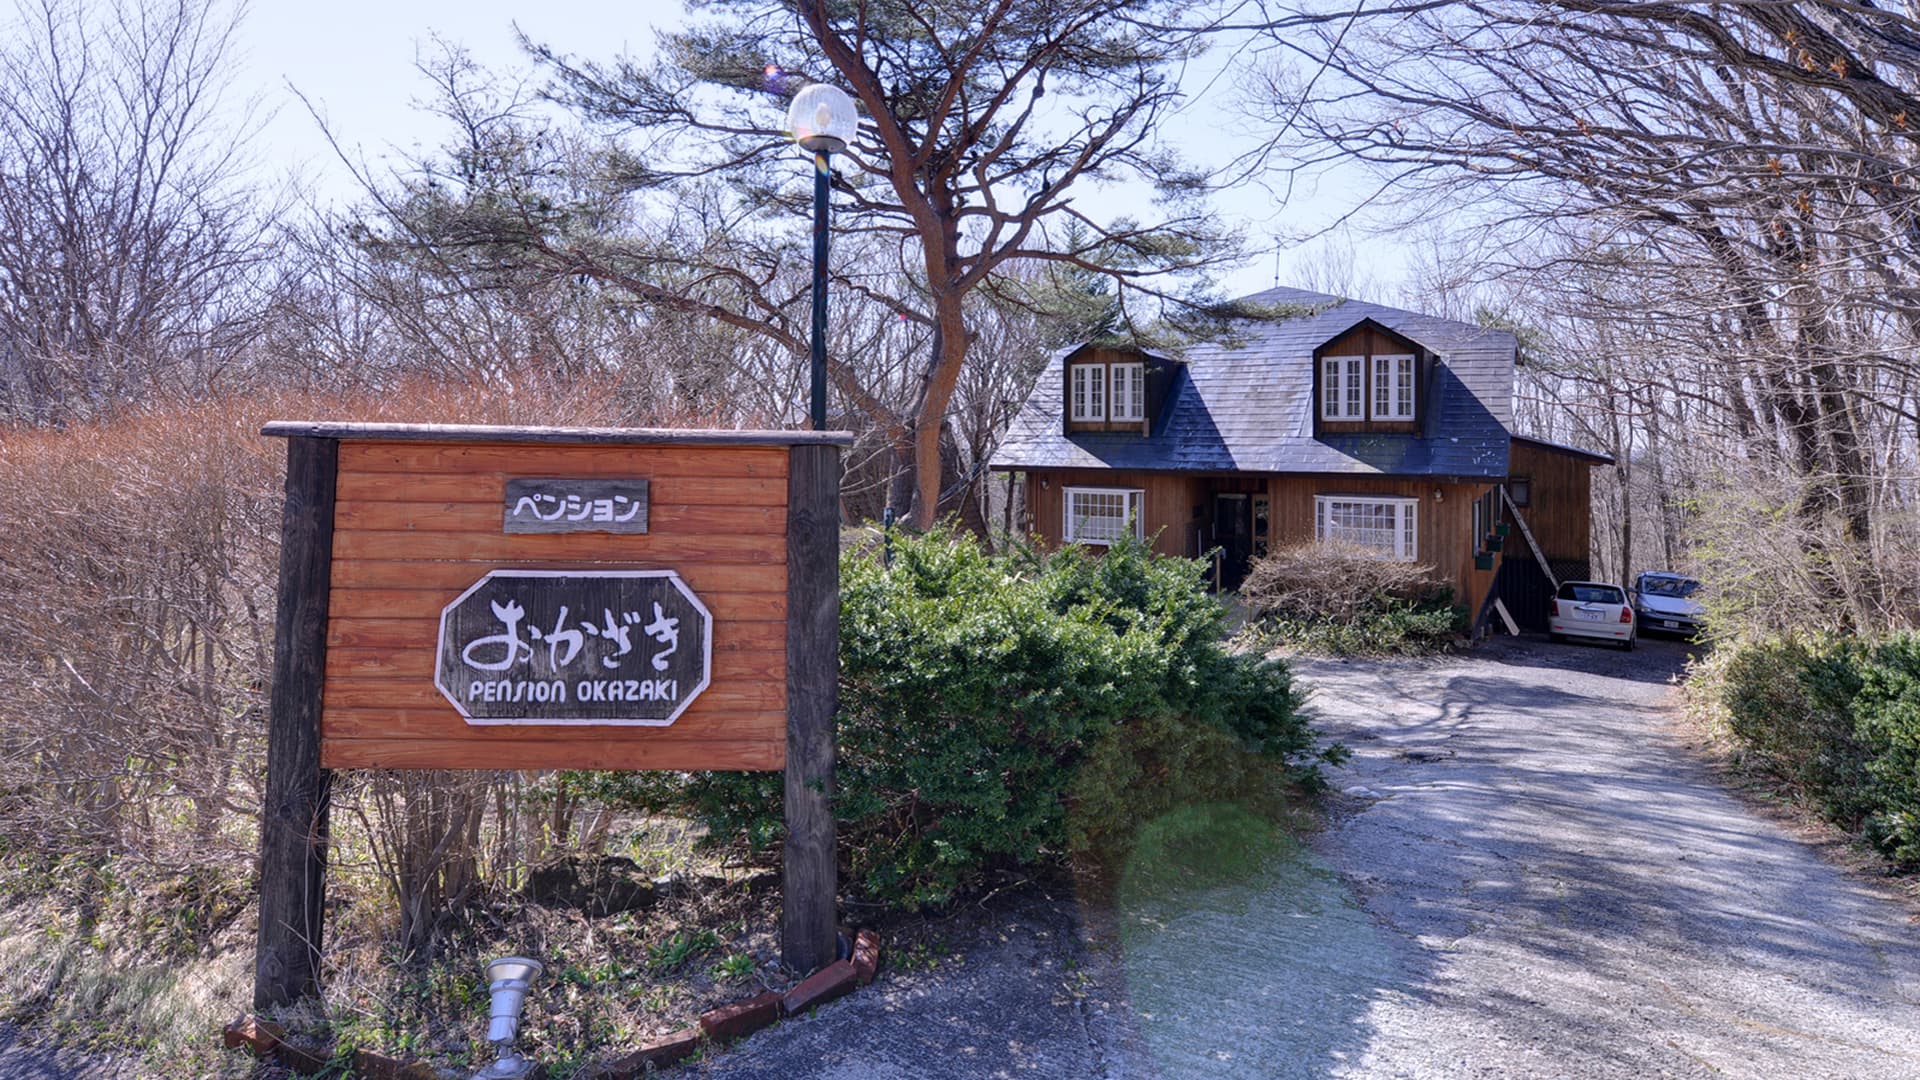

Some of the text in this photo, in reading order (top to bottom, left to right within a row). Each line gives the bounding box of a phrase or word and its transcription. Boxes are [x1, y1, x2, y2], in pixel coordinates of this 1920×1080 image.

[513, 493, 640, 522] ペンション
[462, 599, 680, 673] おかざき
[469, 679, 678, 703] PENSION OKAZAKI
